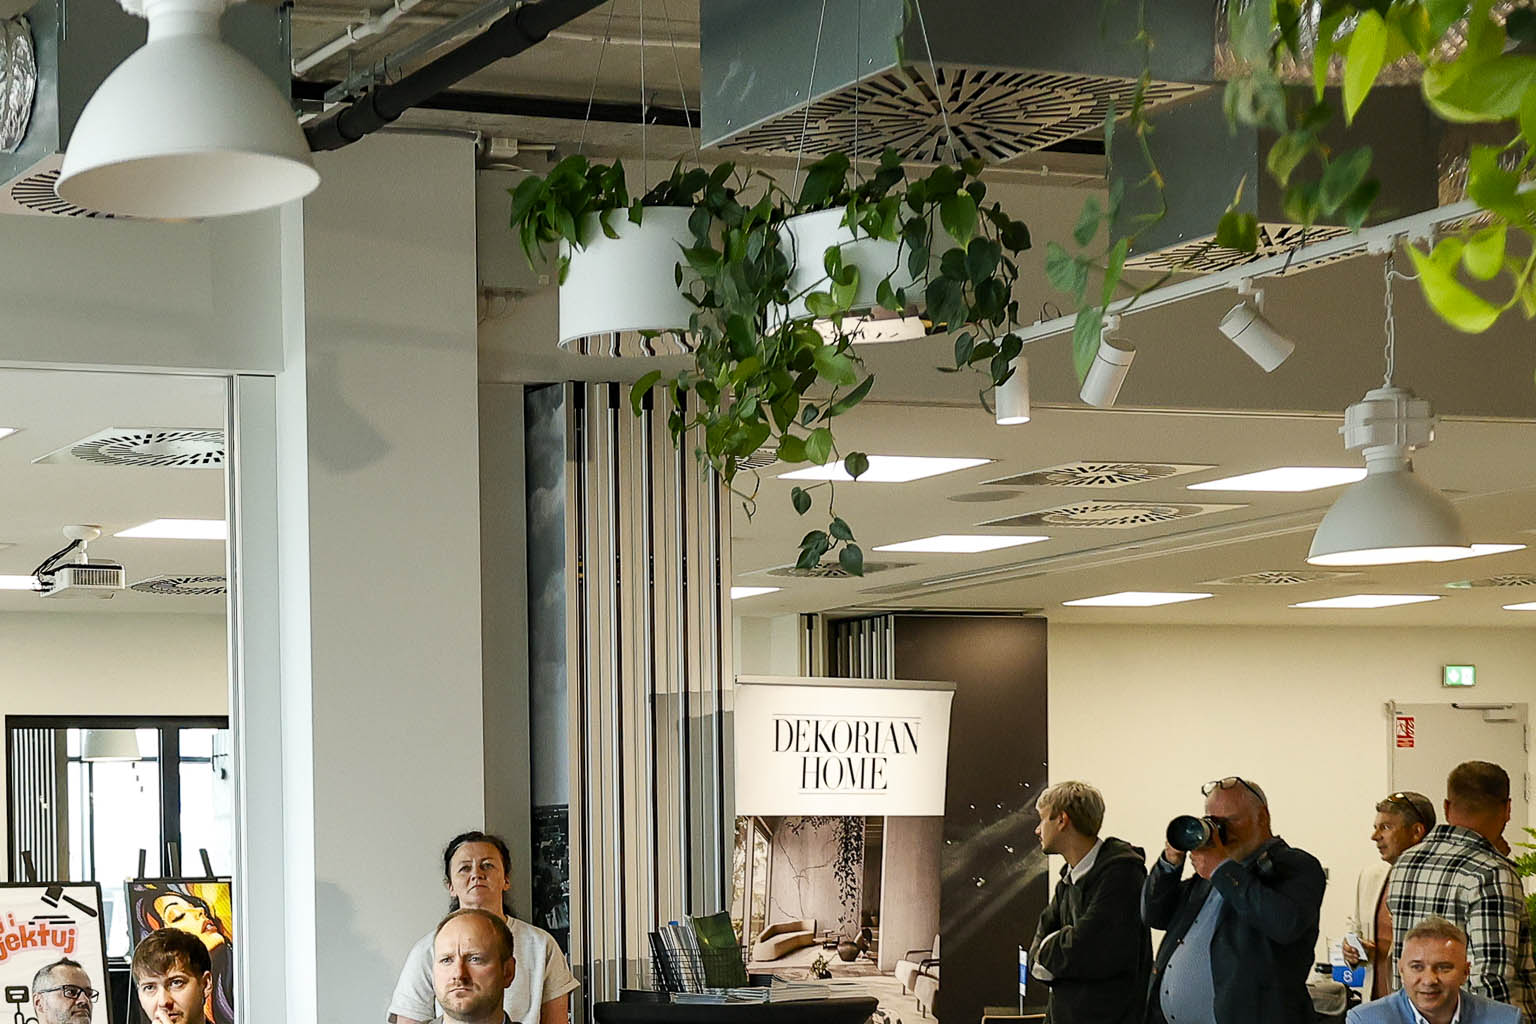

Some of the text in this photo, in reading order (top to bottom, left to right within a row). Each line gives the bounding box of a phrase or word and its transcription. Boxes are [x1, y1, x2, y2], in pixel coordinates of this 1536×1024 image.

[772, 718, 921, 755] DEKORIAN
[800, 755, 888, 790] HOME
[8, 913, 15, 927] i
